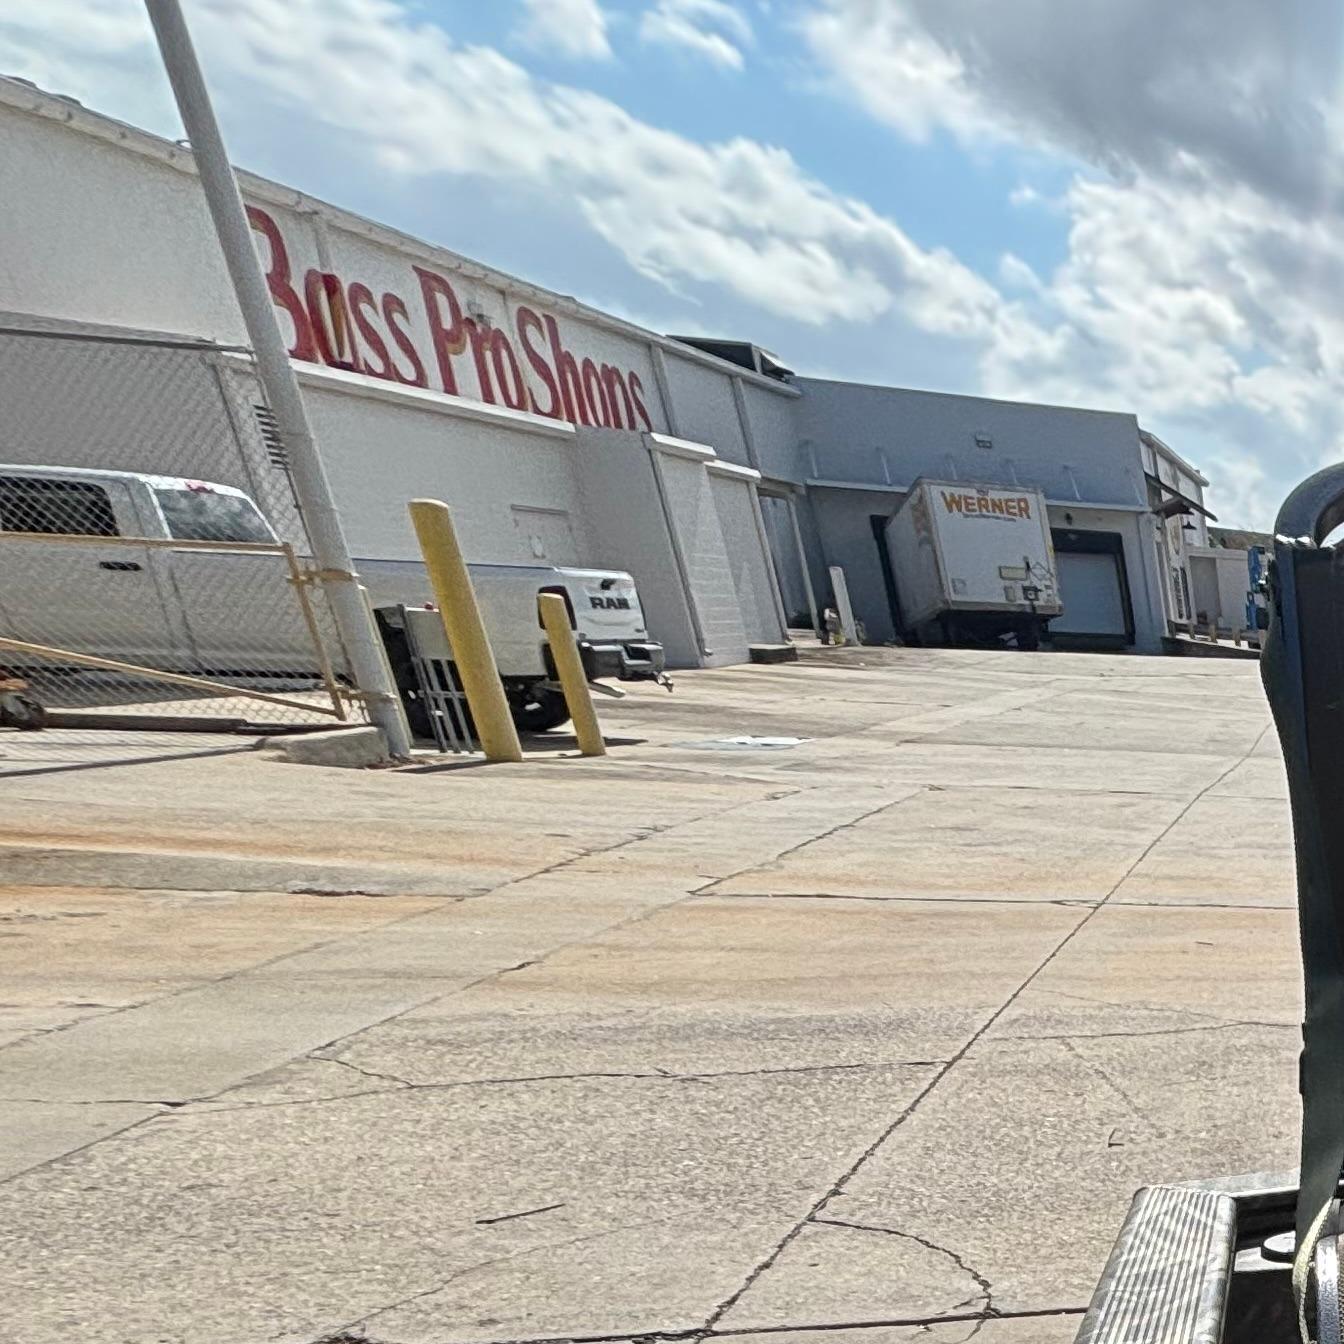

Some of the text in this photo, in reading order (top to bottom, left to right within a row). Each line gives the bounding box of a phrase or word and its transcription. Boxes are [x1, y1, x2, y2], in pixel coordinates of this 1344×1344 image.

[245, 204, 429, 389] Bass
[412, 265, 529, 411] Pro
[941, 491, 1031, 519] WERNER
[589, 596, 630, 609] RAM
